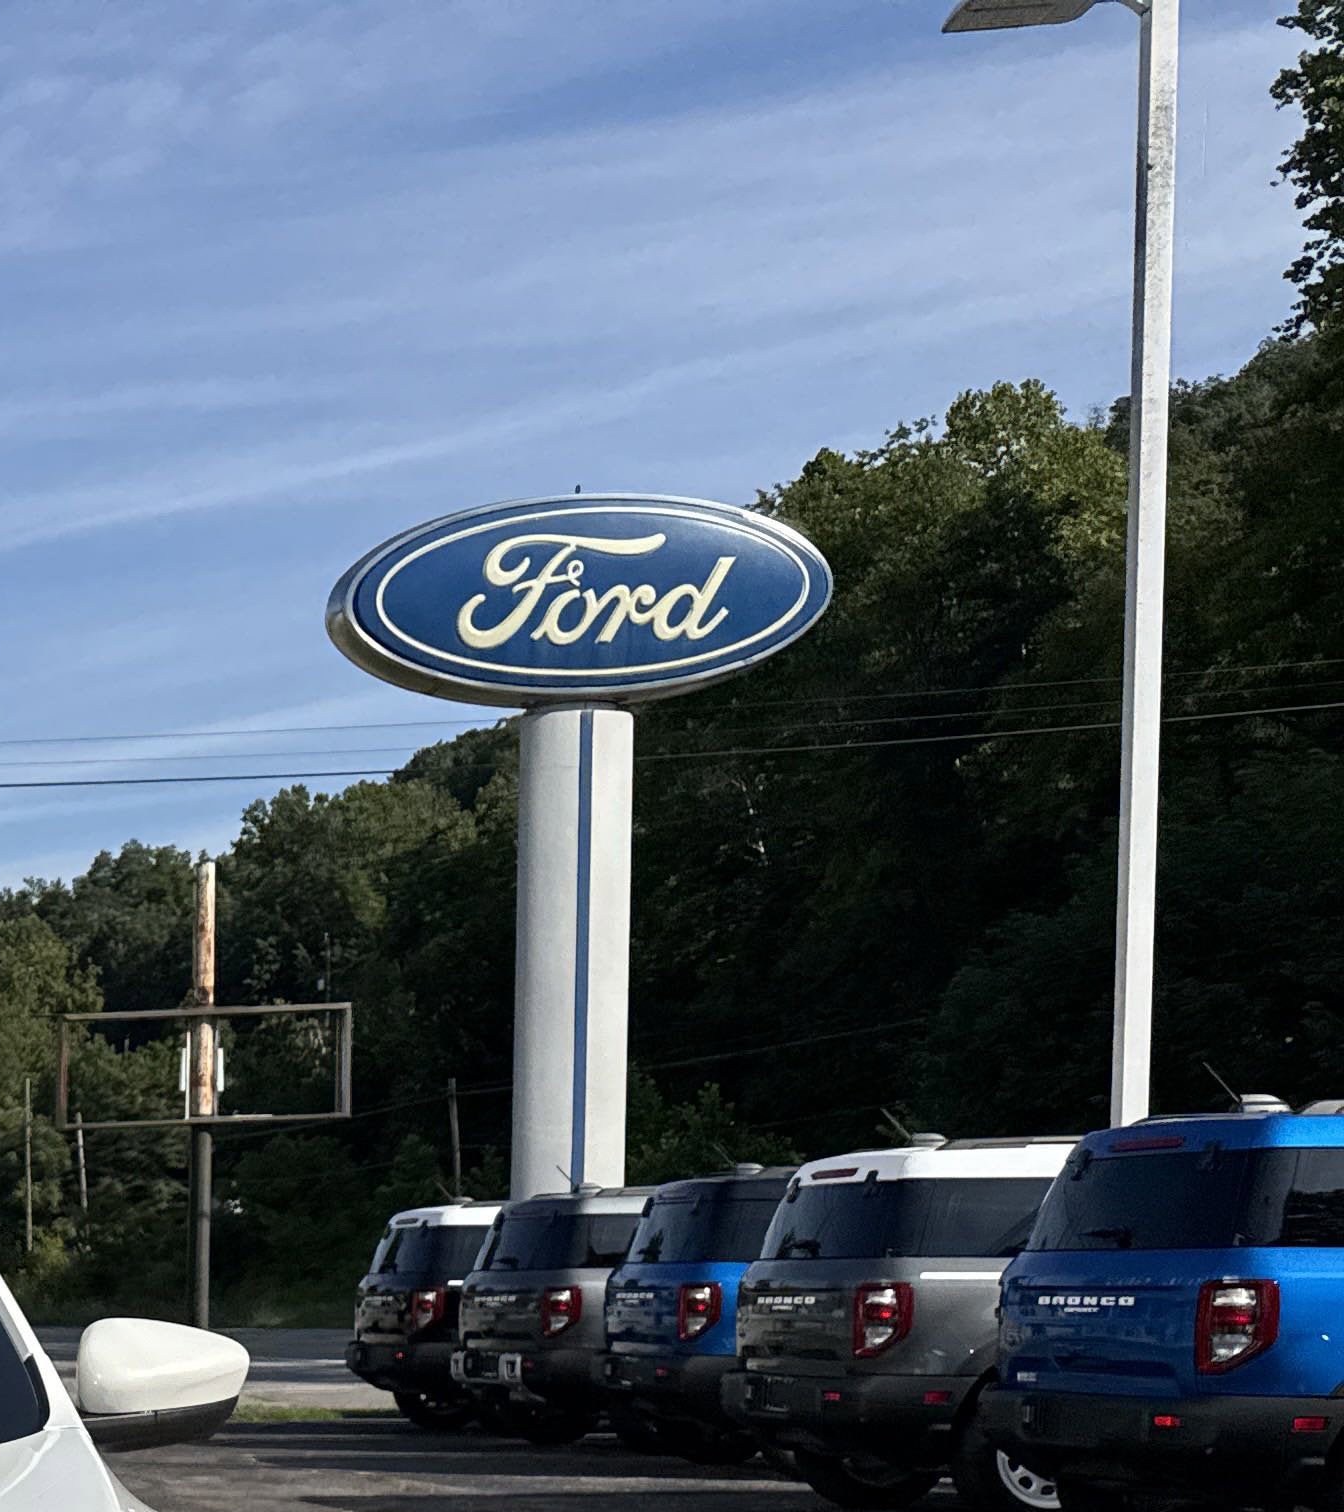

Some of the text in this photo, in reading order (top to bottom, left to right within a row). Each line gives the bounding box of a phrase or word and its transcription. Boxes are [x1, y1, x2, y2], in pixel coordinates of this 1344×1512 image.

[457, 532, 737, 649] Ford
[757, 1296, 816, 1305] BRONCO
[1037, 1296, 1135, 1306] BRONCO
